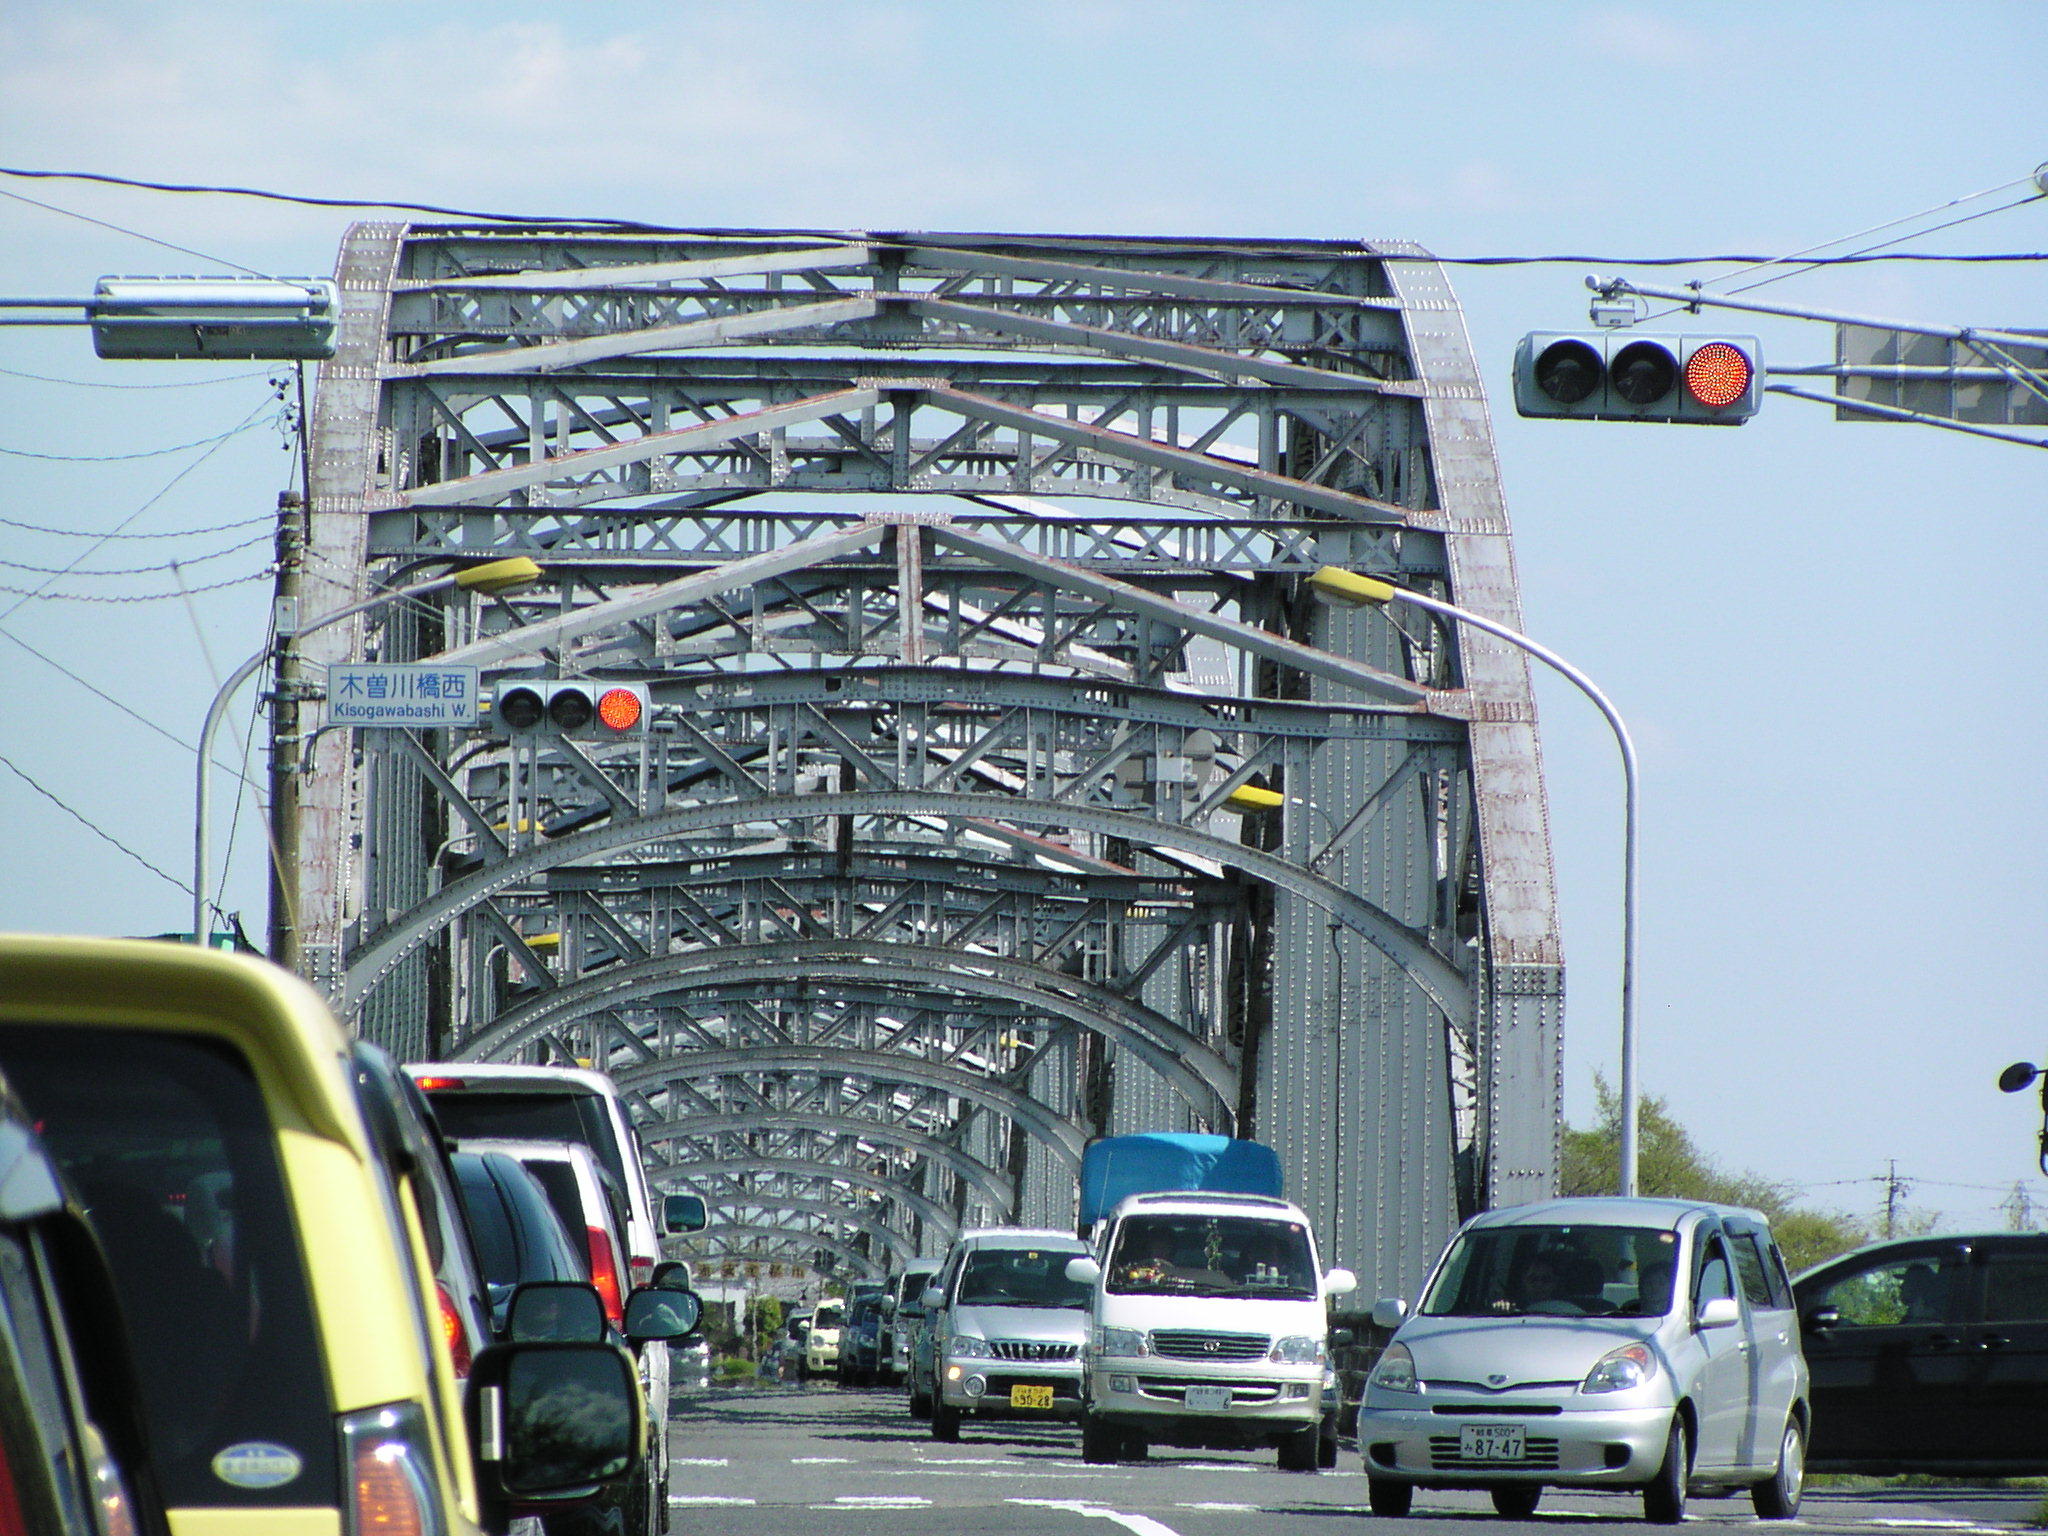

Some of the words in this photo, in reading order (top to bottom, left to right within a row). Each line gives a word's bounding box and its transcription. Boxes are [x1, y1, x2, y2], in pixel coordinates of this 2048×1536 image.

[339, 672, 466, 699] 木曽川橋西
[334, 703, 445, 719] Kisogawabashi
[452, 703, 471, 718] W.
[1475, 1439, 1521, 1457] 87-47
